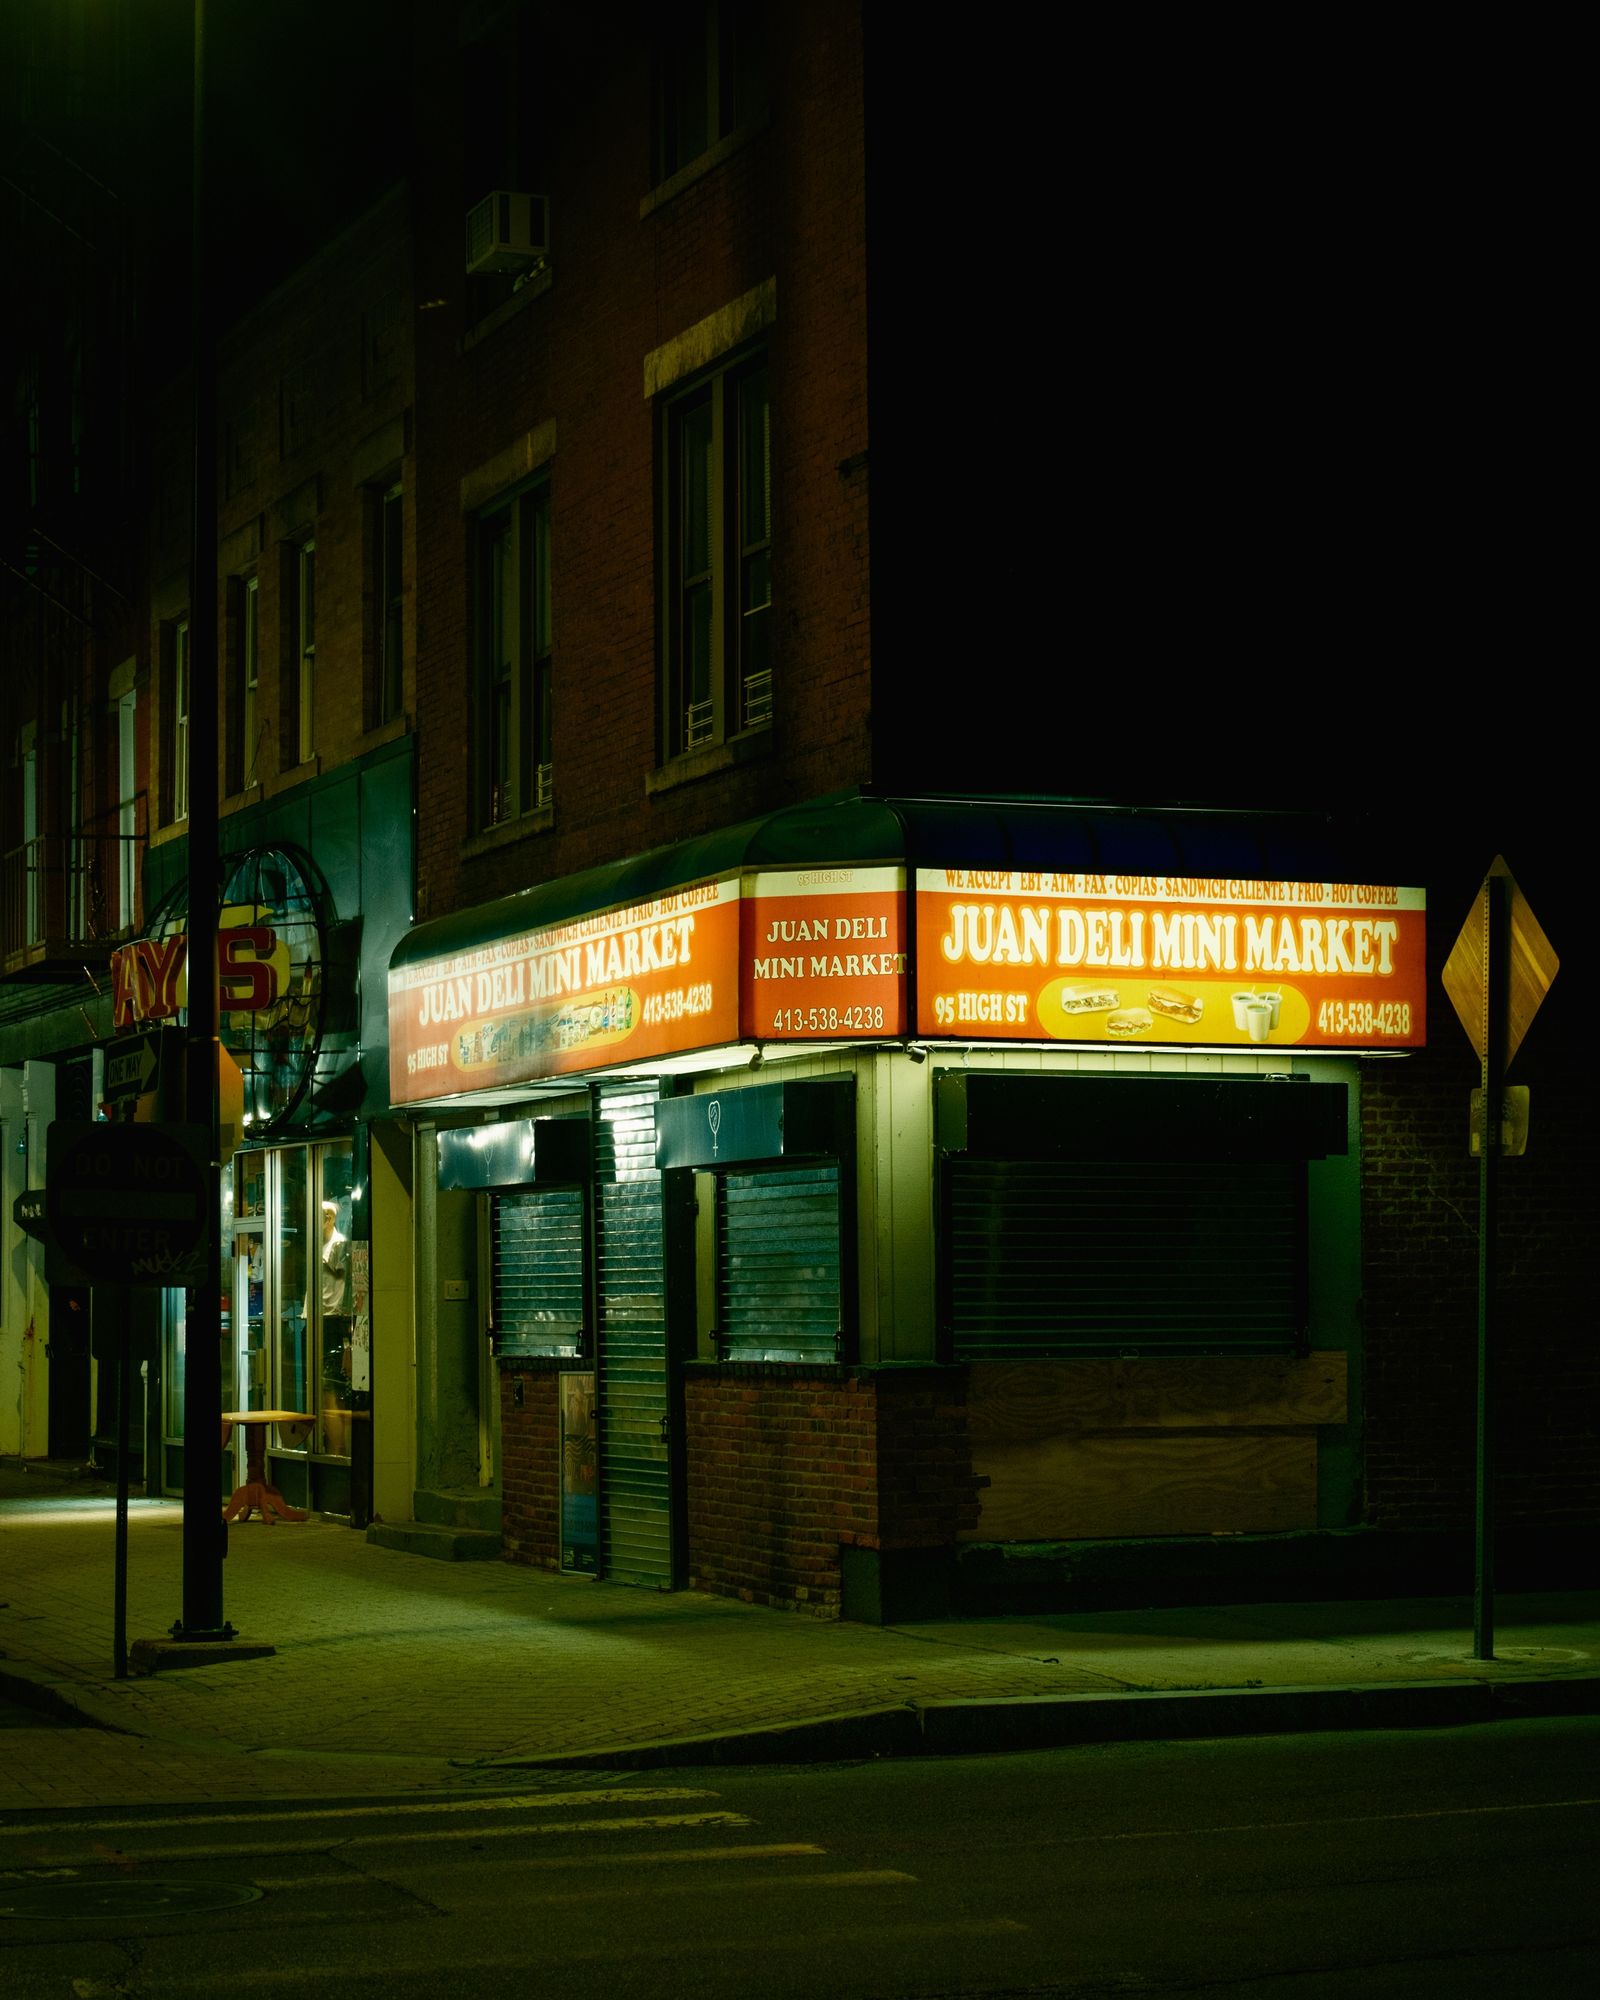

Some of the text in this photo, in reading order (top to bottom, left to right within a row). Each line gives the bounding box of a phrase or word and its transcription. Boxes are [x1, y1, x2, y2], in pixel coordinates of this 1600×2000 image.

[798, 870, 854, 886] 95 HIGH ST
[945, 870, 1399, 906] WE ACCEPT EBT ATM FAX COPIAS SANDWICH CALIENTE Y FRIO HOT COFFEE
[535, 918, 578, 951] SANDWICH
[579, 905, 622, 938] CALIENTE
[631, 894, 655, 922] FRIO
[660, 888, 681, 915] HOT
[681, 878, 719, 909] COFFEE
[766, 916, 888, 943] JUAN DELI
[943, 903, 1398, 975] JUAN DELI MINI MARKET
[418, 914, 695, 1027] JUAN DELI MINI MARKET
[753, 952, 908, 980] MINI MARKET
[642, 983, 713, 1024] 413-538-4238
[773, 1006, 884, 1032] 413-538-4238
[935, 992, 1028, 1025] 95 HIGH ST
[1318, 1001, 1411, 1035] 413-538-4238
[417, 1045, 438, 1070] HIGH
[438, 1042, 449, 1066] ST
